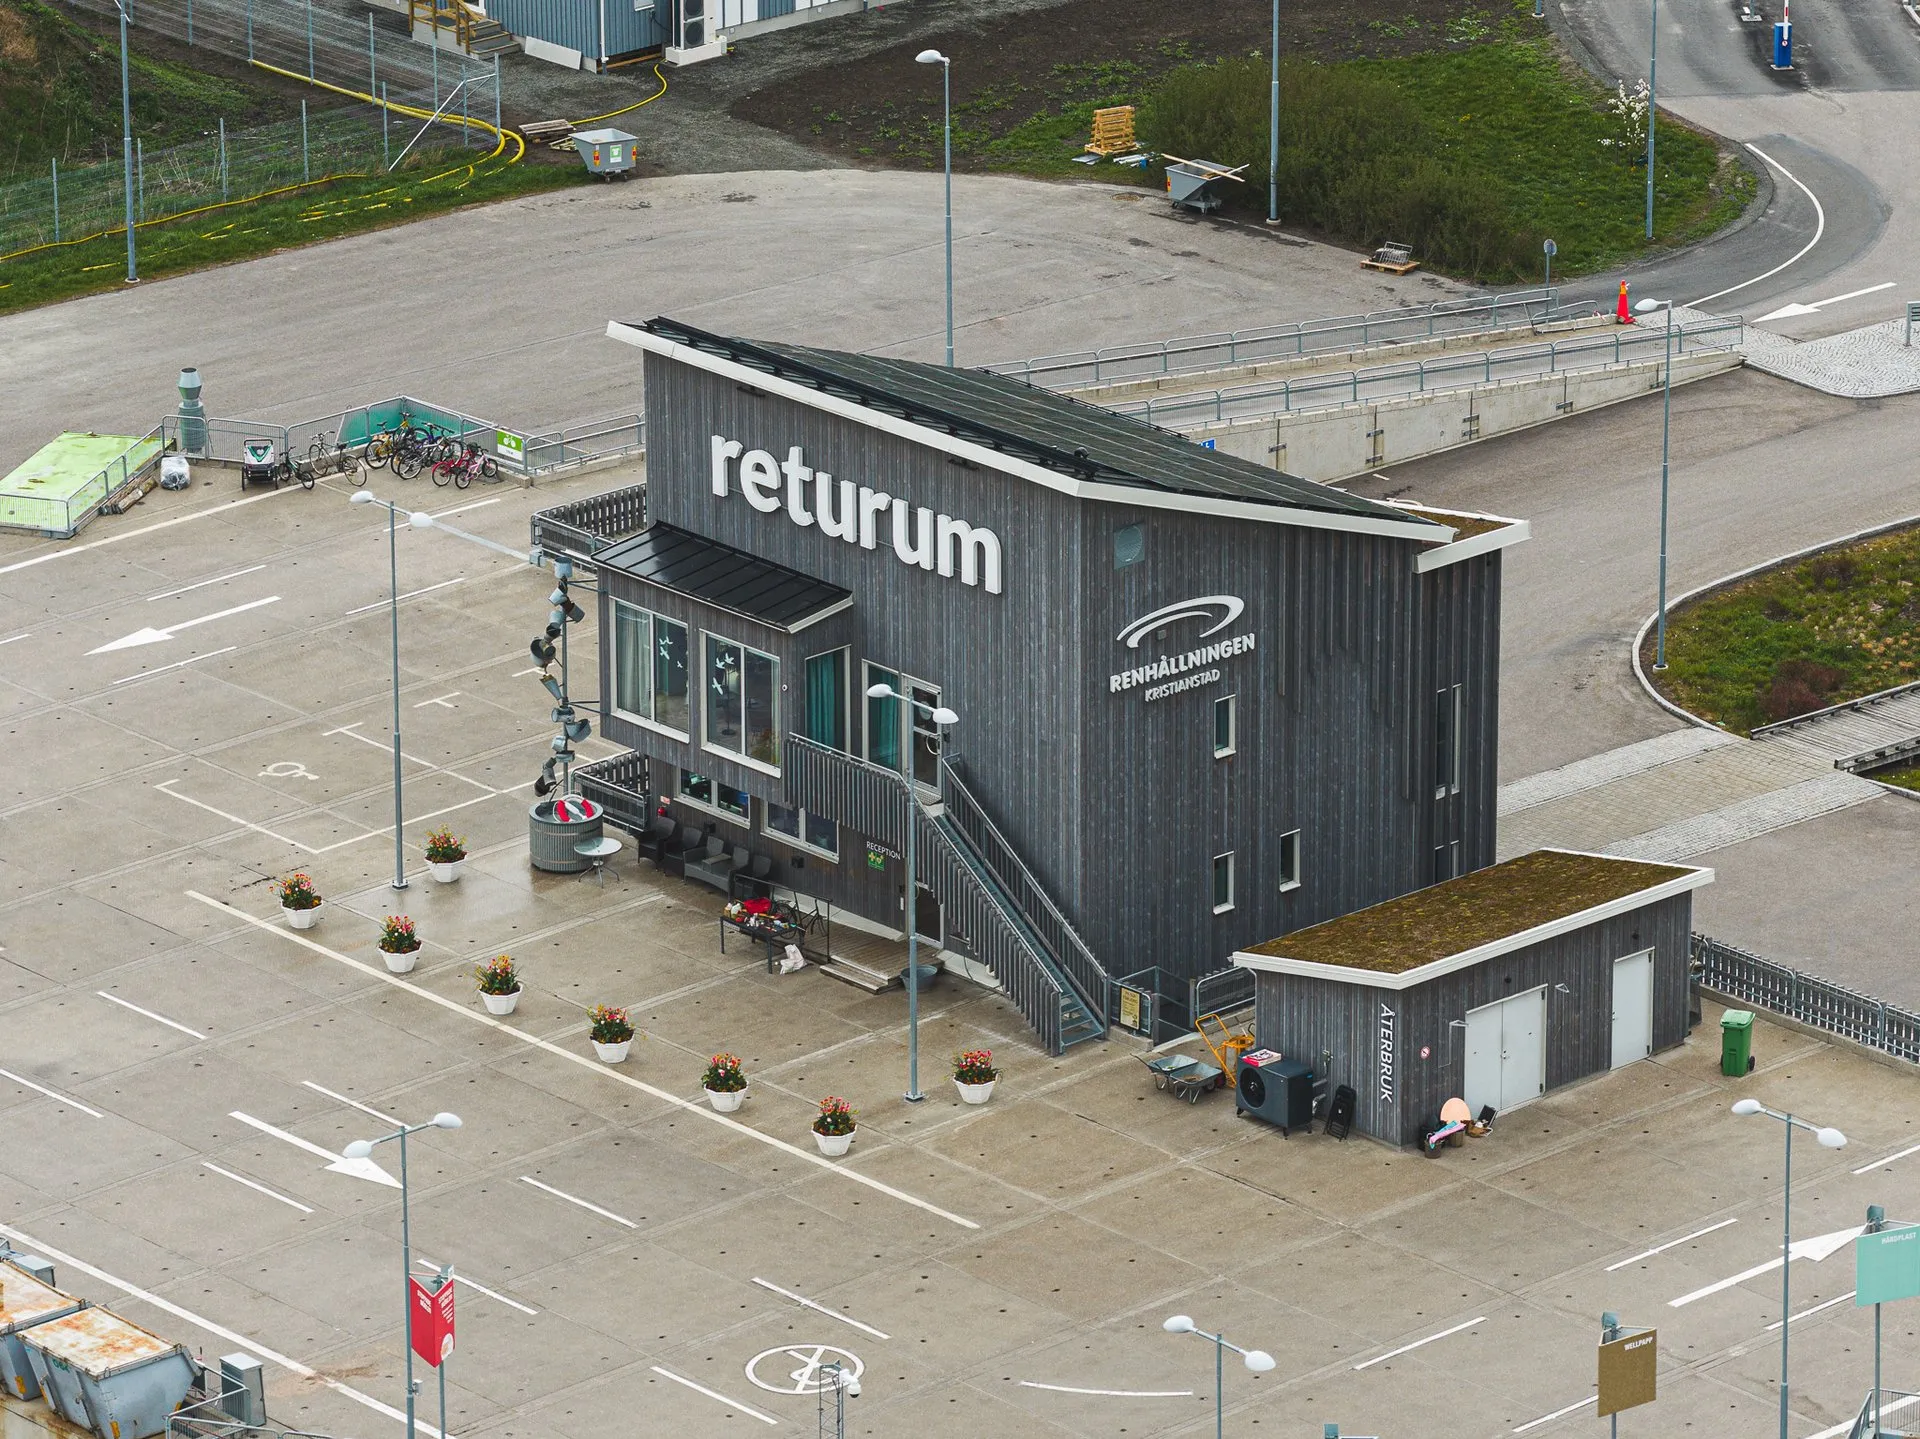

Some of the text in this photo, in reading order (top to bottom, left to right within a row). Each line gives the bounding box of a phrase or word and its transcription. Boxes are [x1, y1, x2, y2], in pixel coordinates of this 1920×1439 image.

[711, 434, 1001, 595] returum
[1109, 633, 1255, 693] RENHÅLLNINGEN
[1144, 669, 1221, 702] KRISTIANSTAD
[866, 841, 900, 860] RECEPTION
[1380, 1003, 1396, 1104] ÅTERBRUK
